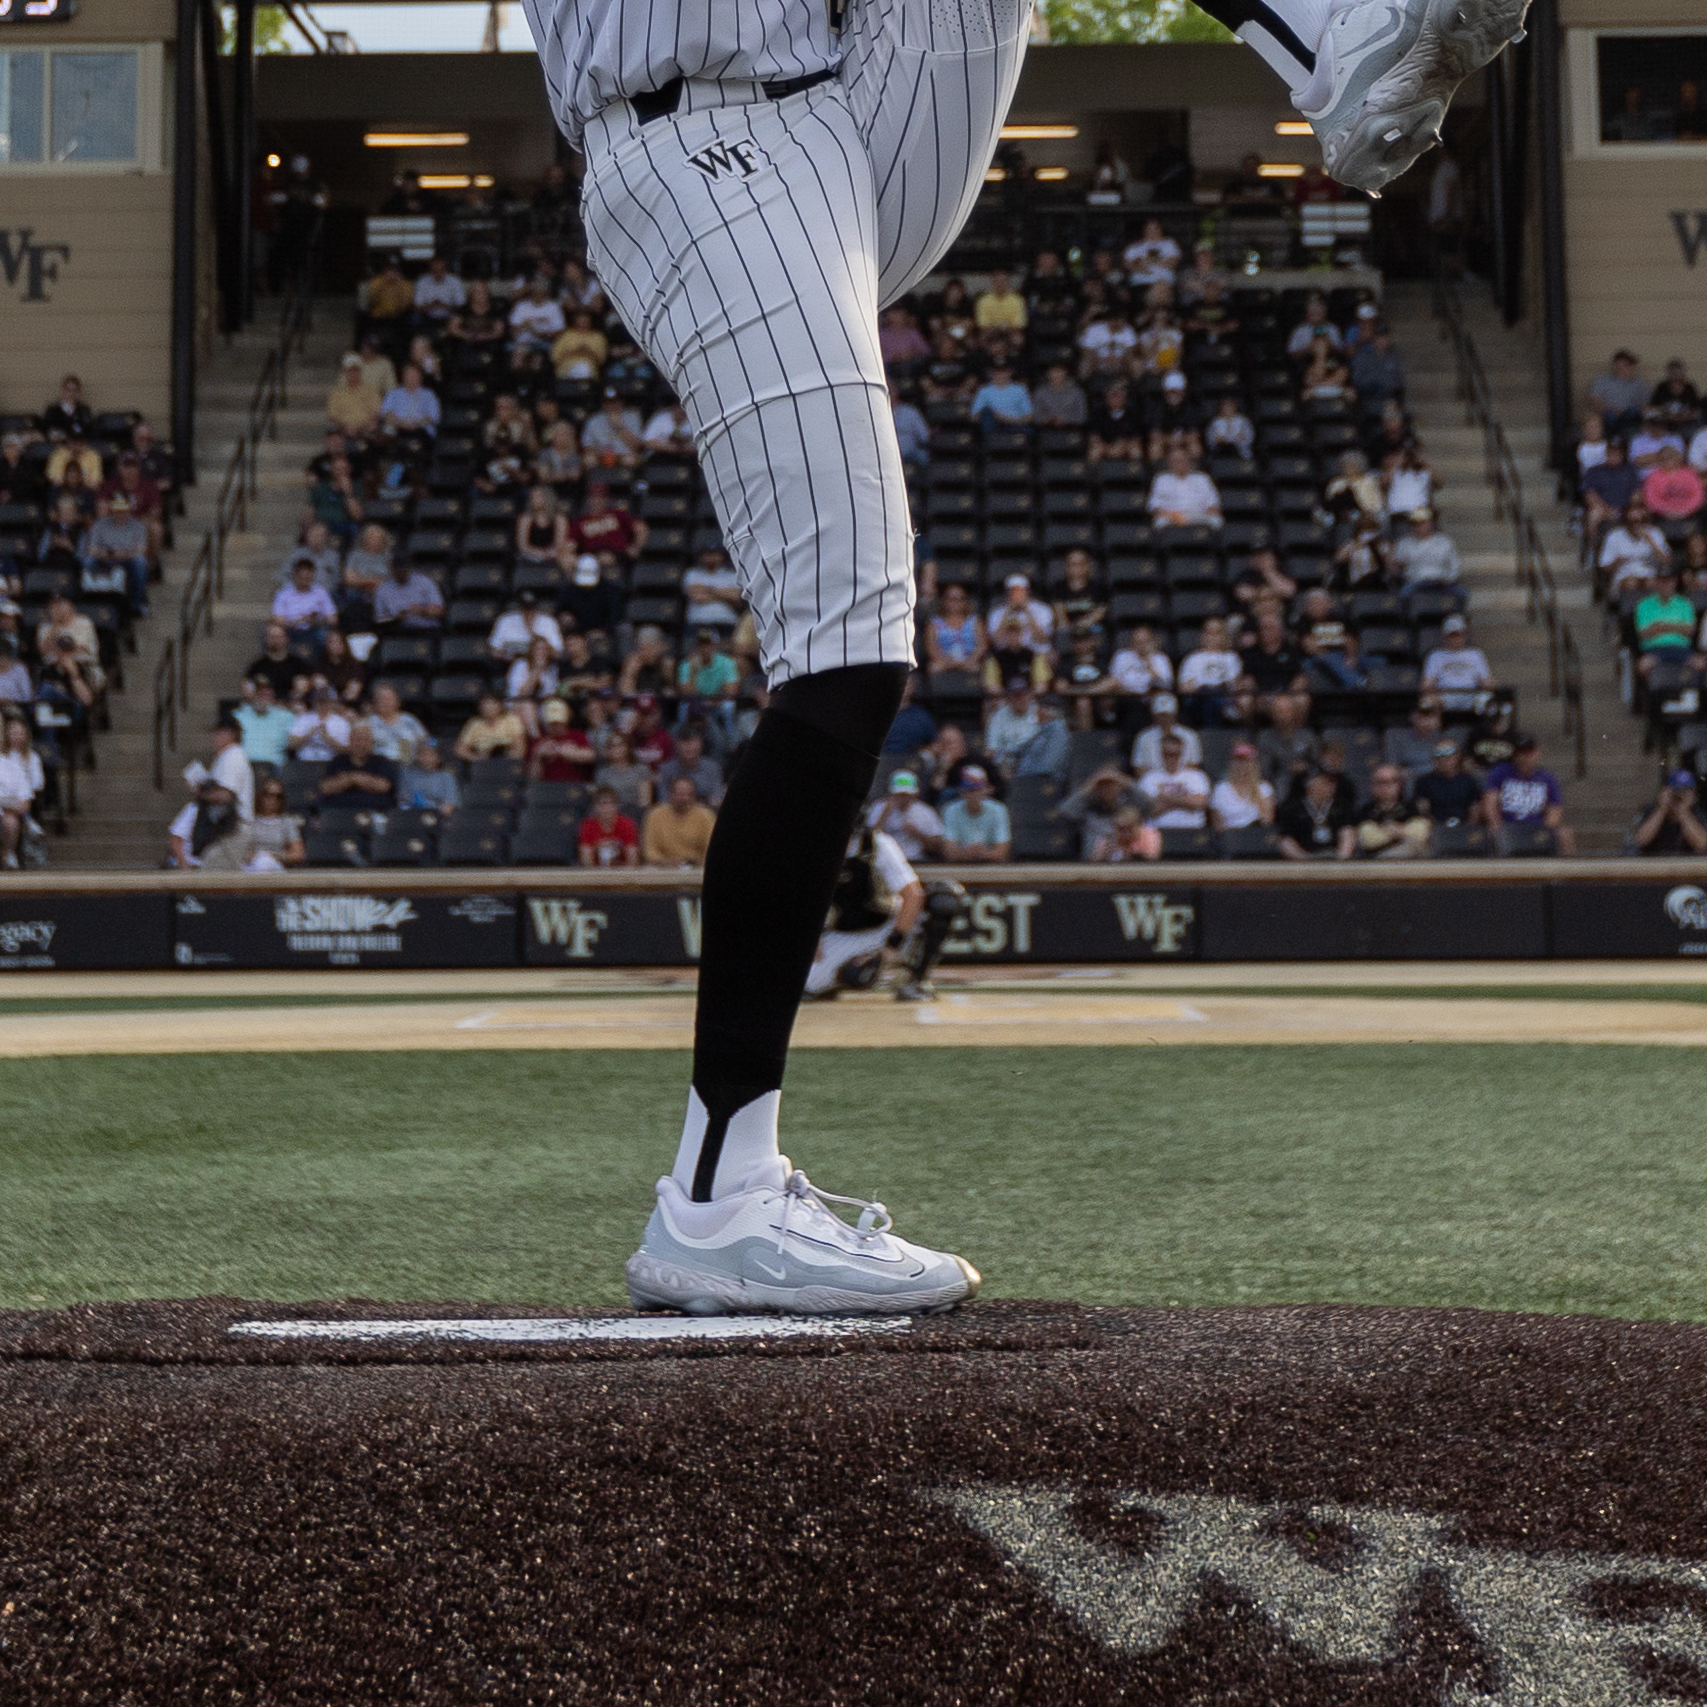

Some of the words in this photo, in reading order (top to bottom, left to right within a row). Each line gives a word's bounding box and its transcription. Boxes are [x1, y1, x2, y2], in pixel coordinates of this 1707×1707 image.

[686, 138, 760, 180] WF
[527, 896, 610, 958] WF
[1112, 893, 1194, 952] WF
